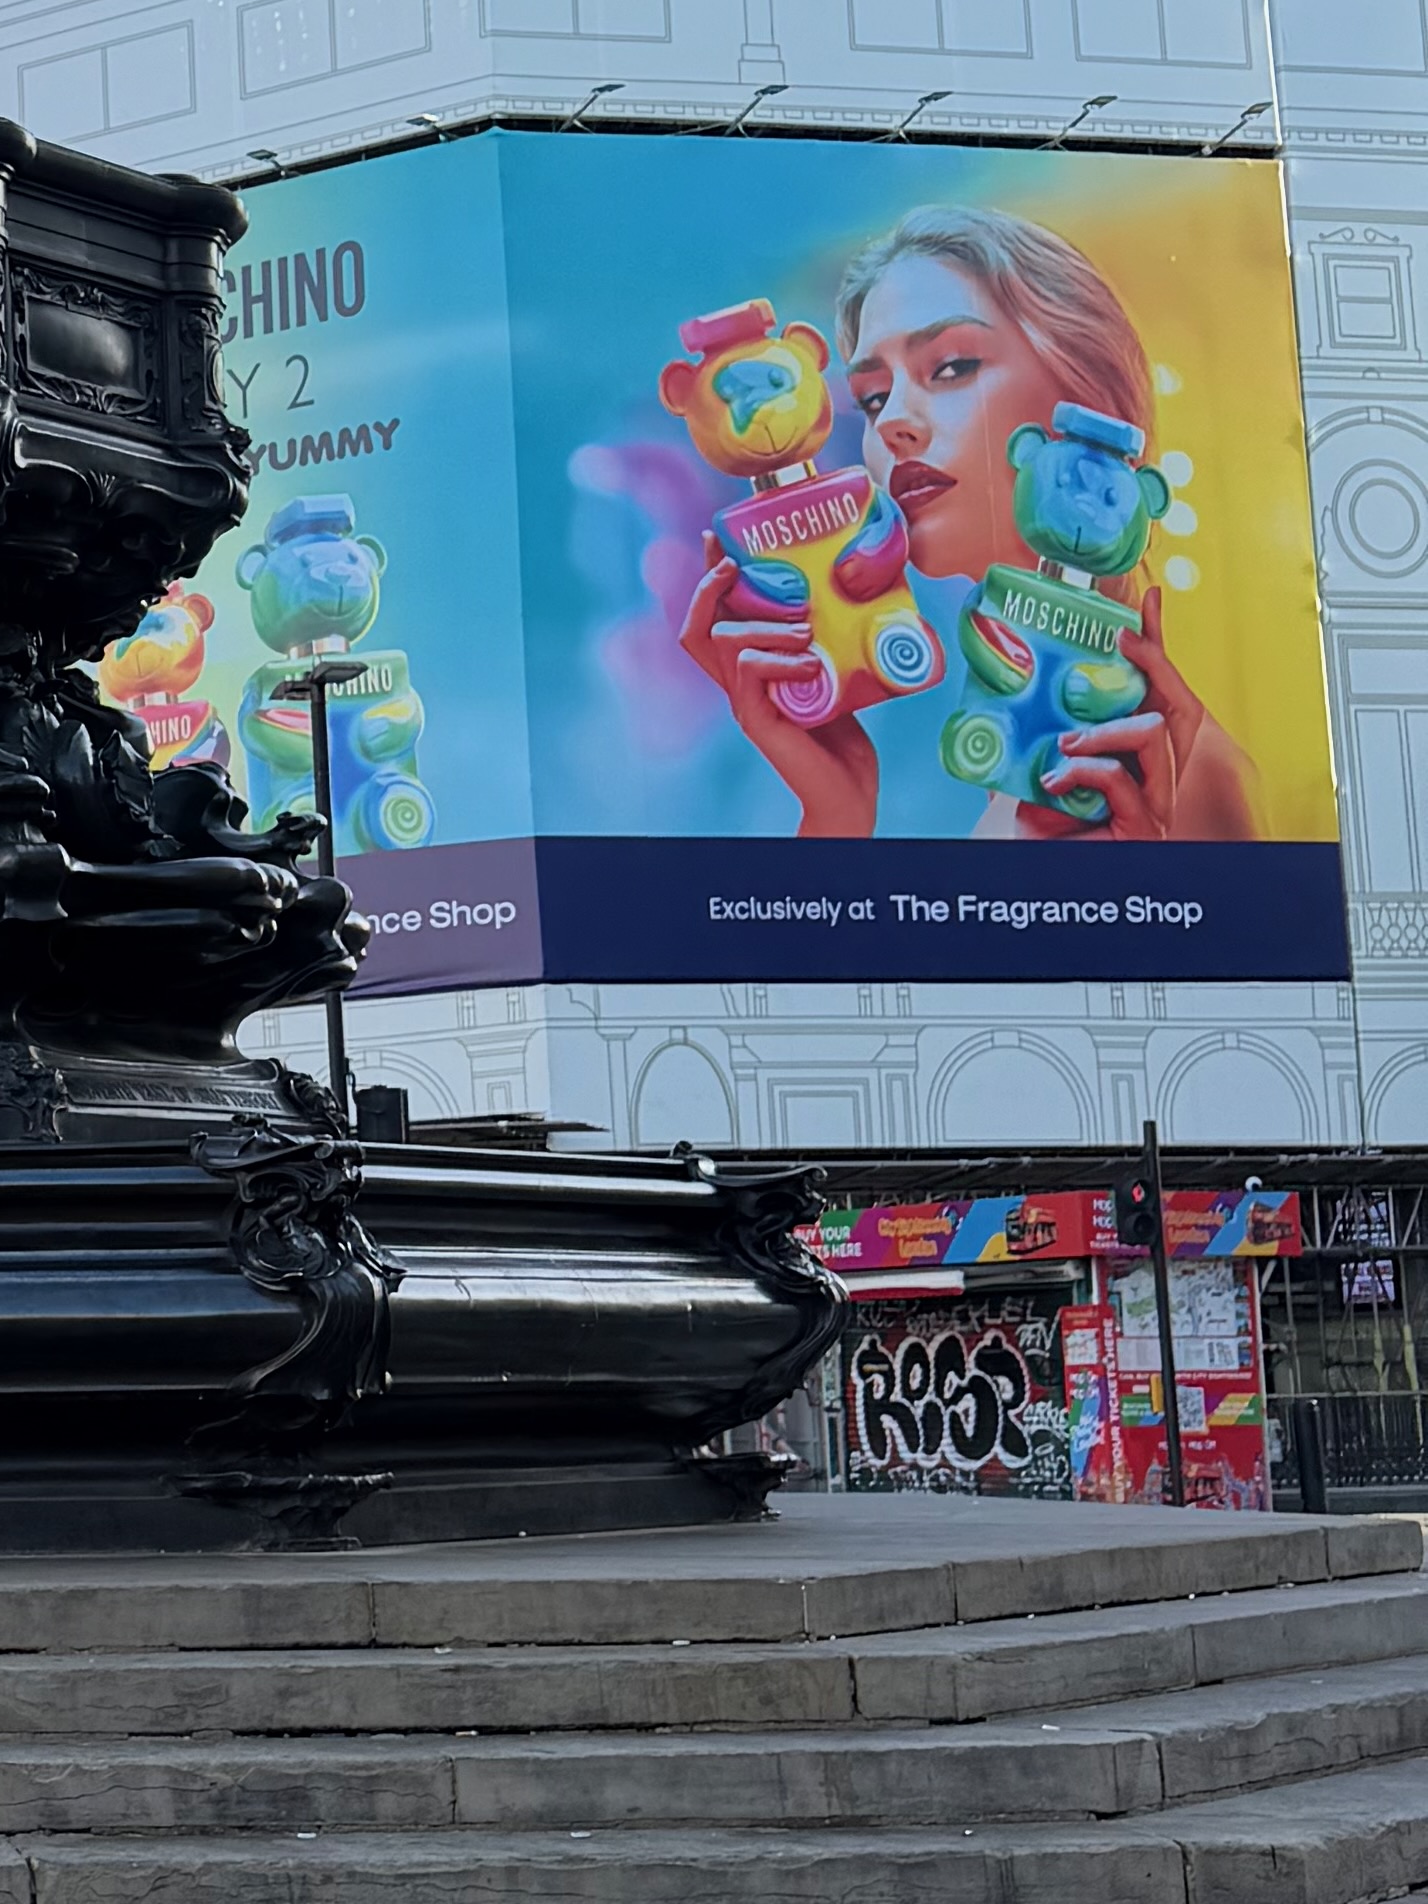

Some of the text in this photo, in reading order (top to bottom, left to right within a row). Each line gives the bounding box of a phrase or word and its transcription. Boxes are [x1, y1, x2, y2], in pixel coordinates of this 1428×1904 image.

[285, 354, 315, 411] 2
[742, 492, 860, 557] MOSCHINO
[1002, 589, 1118, 655] MOSCHINO
[429, 899, 517, 930] Shop
[709, 894, 1204, 931] Exclusively at The Fragrance Shop
[820, 1226, 851, 1241] YOUR
[831, 1242, 863, 1259] HERE
